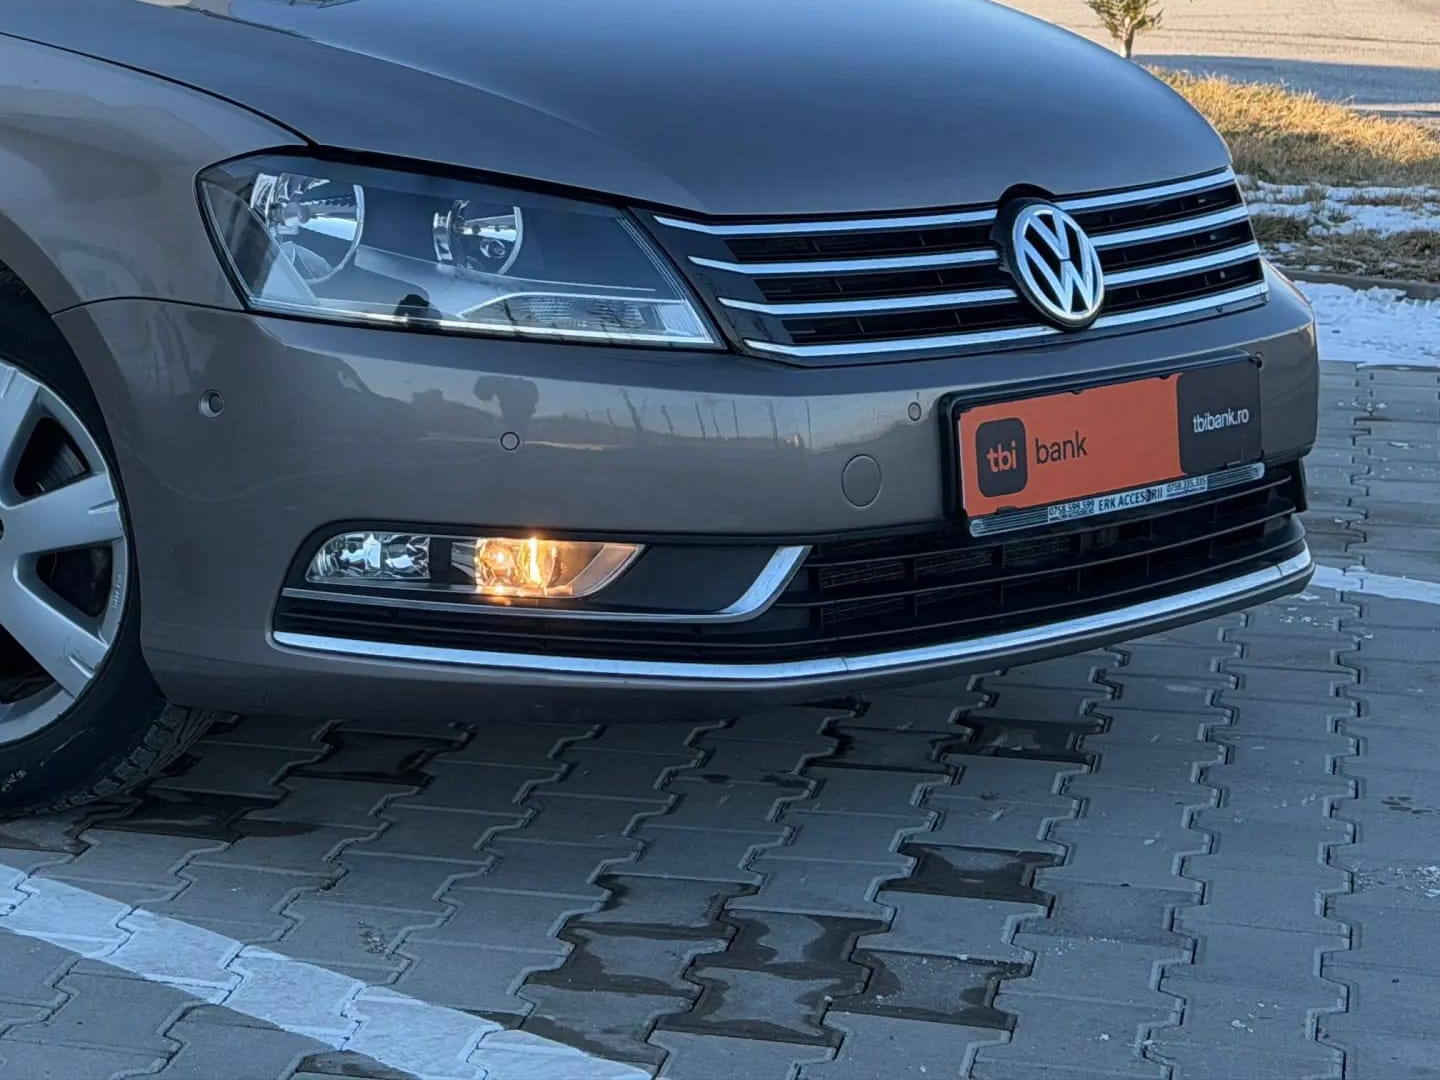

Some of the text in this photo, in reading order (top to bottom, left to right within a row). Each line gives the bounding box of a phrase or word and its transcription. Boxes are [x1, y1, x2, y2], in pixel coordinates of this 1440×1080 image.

[1014, 205, 1103, 319] VW
[1192, 407, 1249, 433] tbibank.ro
[986, 430, 1088, 472] tbi bank
[1098, 497, 1117, 512] ERK
